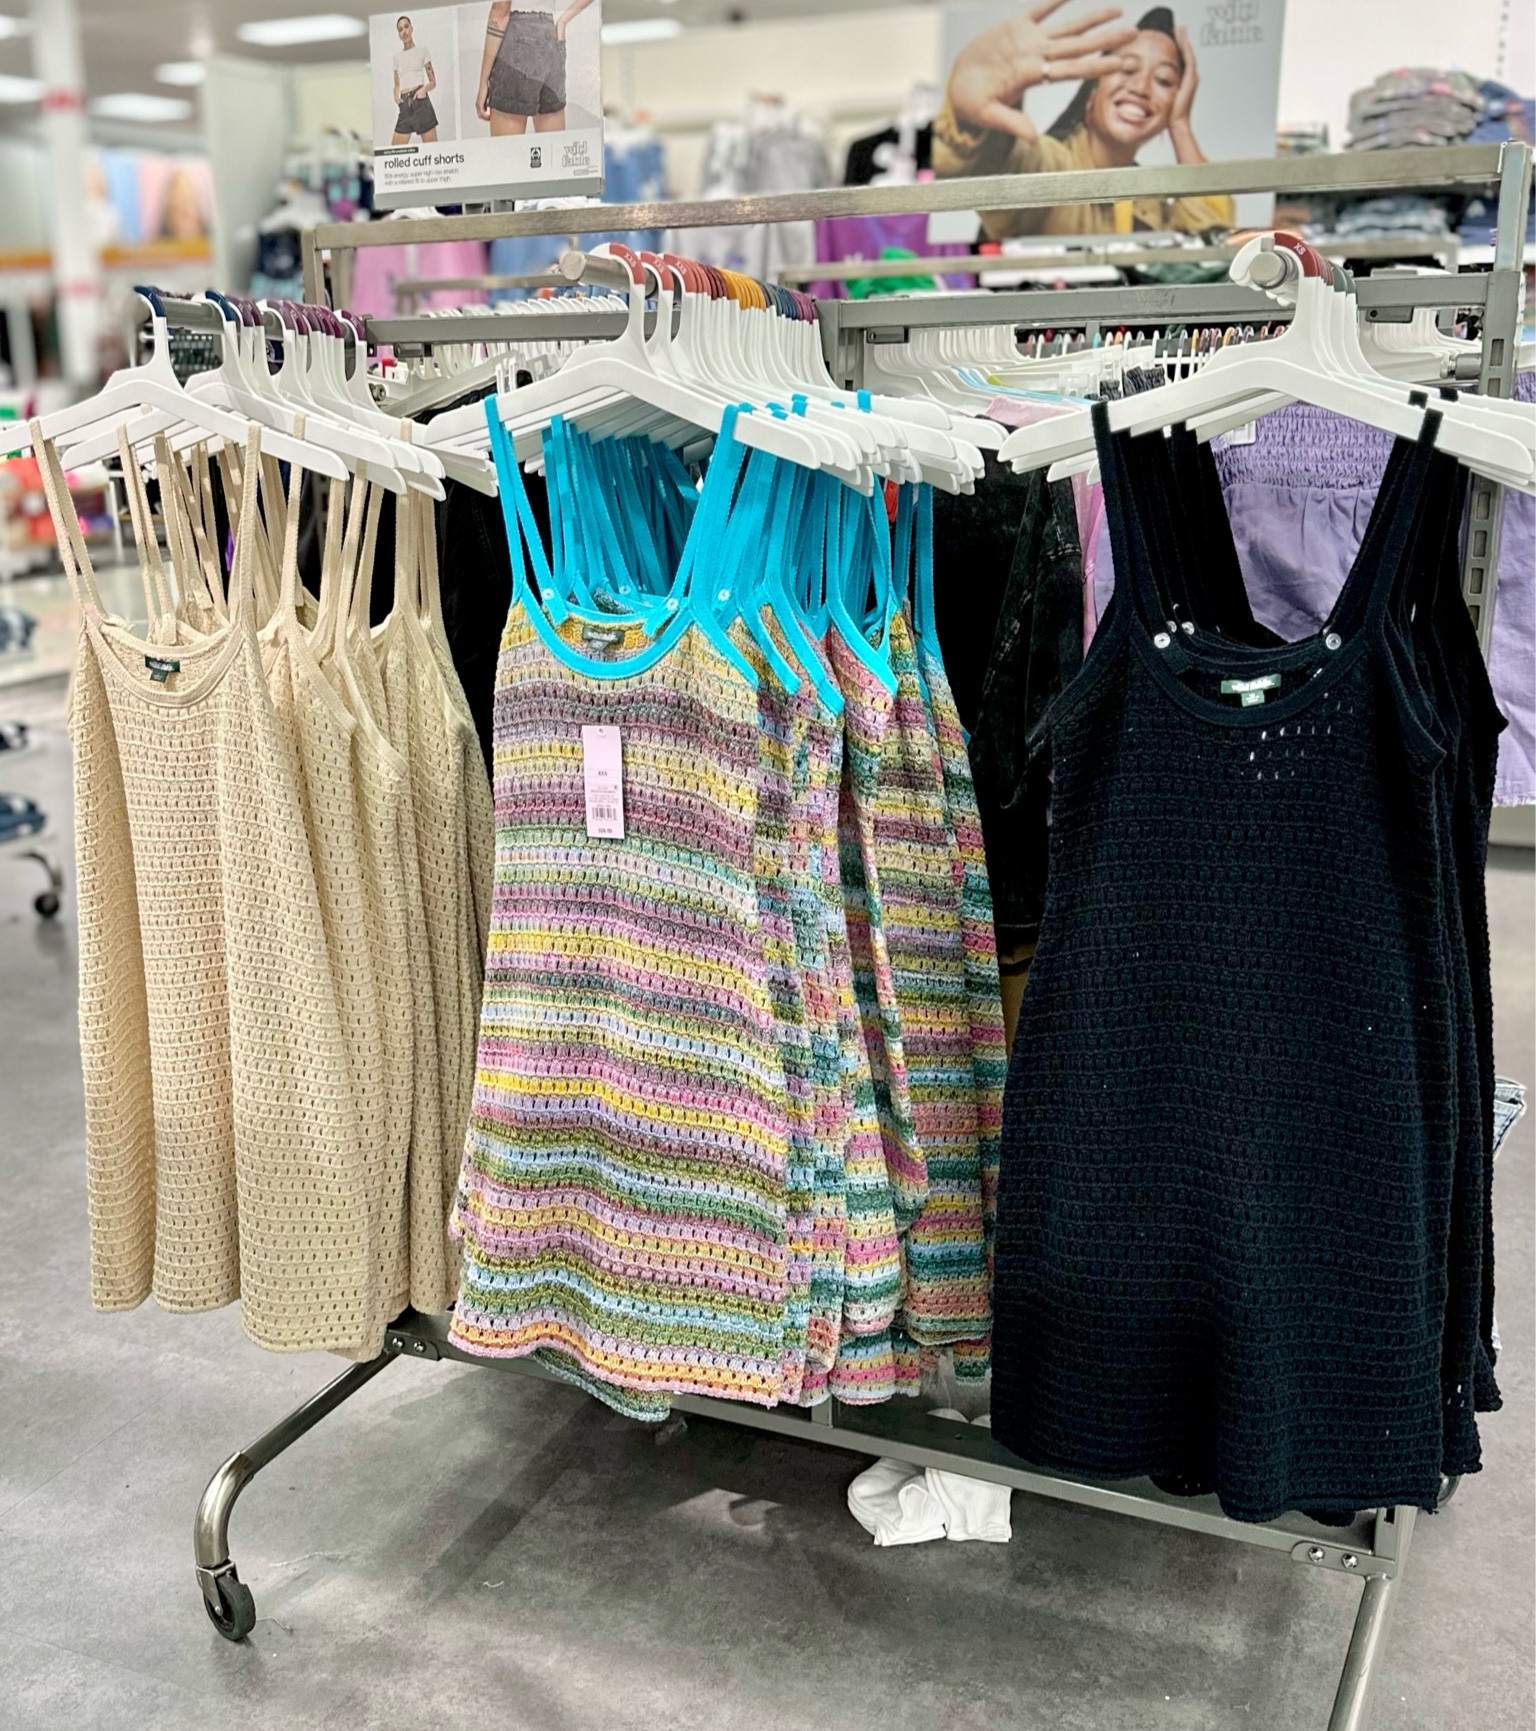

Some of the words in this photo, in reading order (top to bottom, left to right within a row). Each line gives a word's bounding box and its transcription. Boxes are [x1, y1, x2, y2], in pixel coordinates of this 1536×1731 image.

[384, 156, 411, 169] rolled
[412, 154, 432, 167] cuff
[433, 153, 465, 165] shorts
[1293, 242, 1306, 256] XS
[623, 251, 637, 268] XXS
[675, 260, 688, 276] XXS
